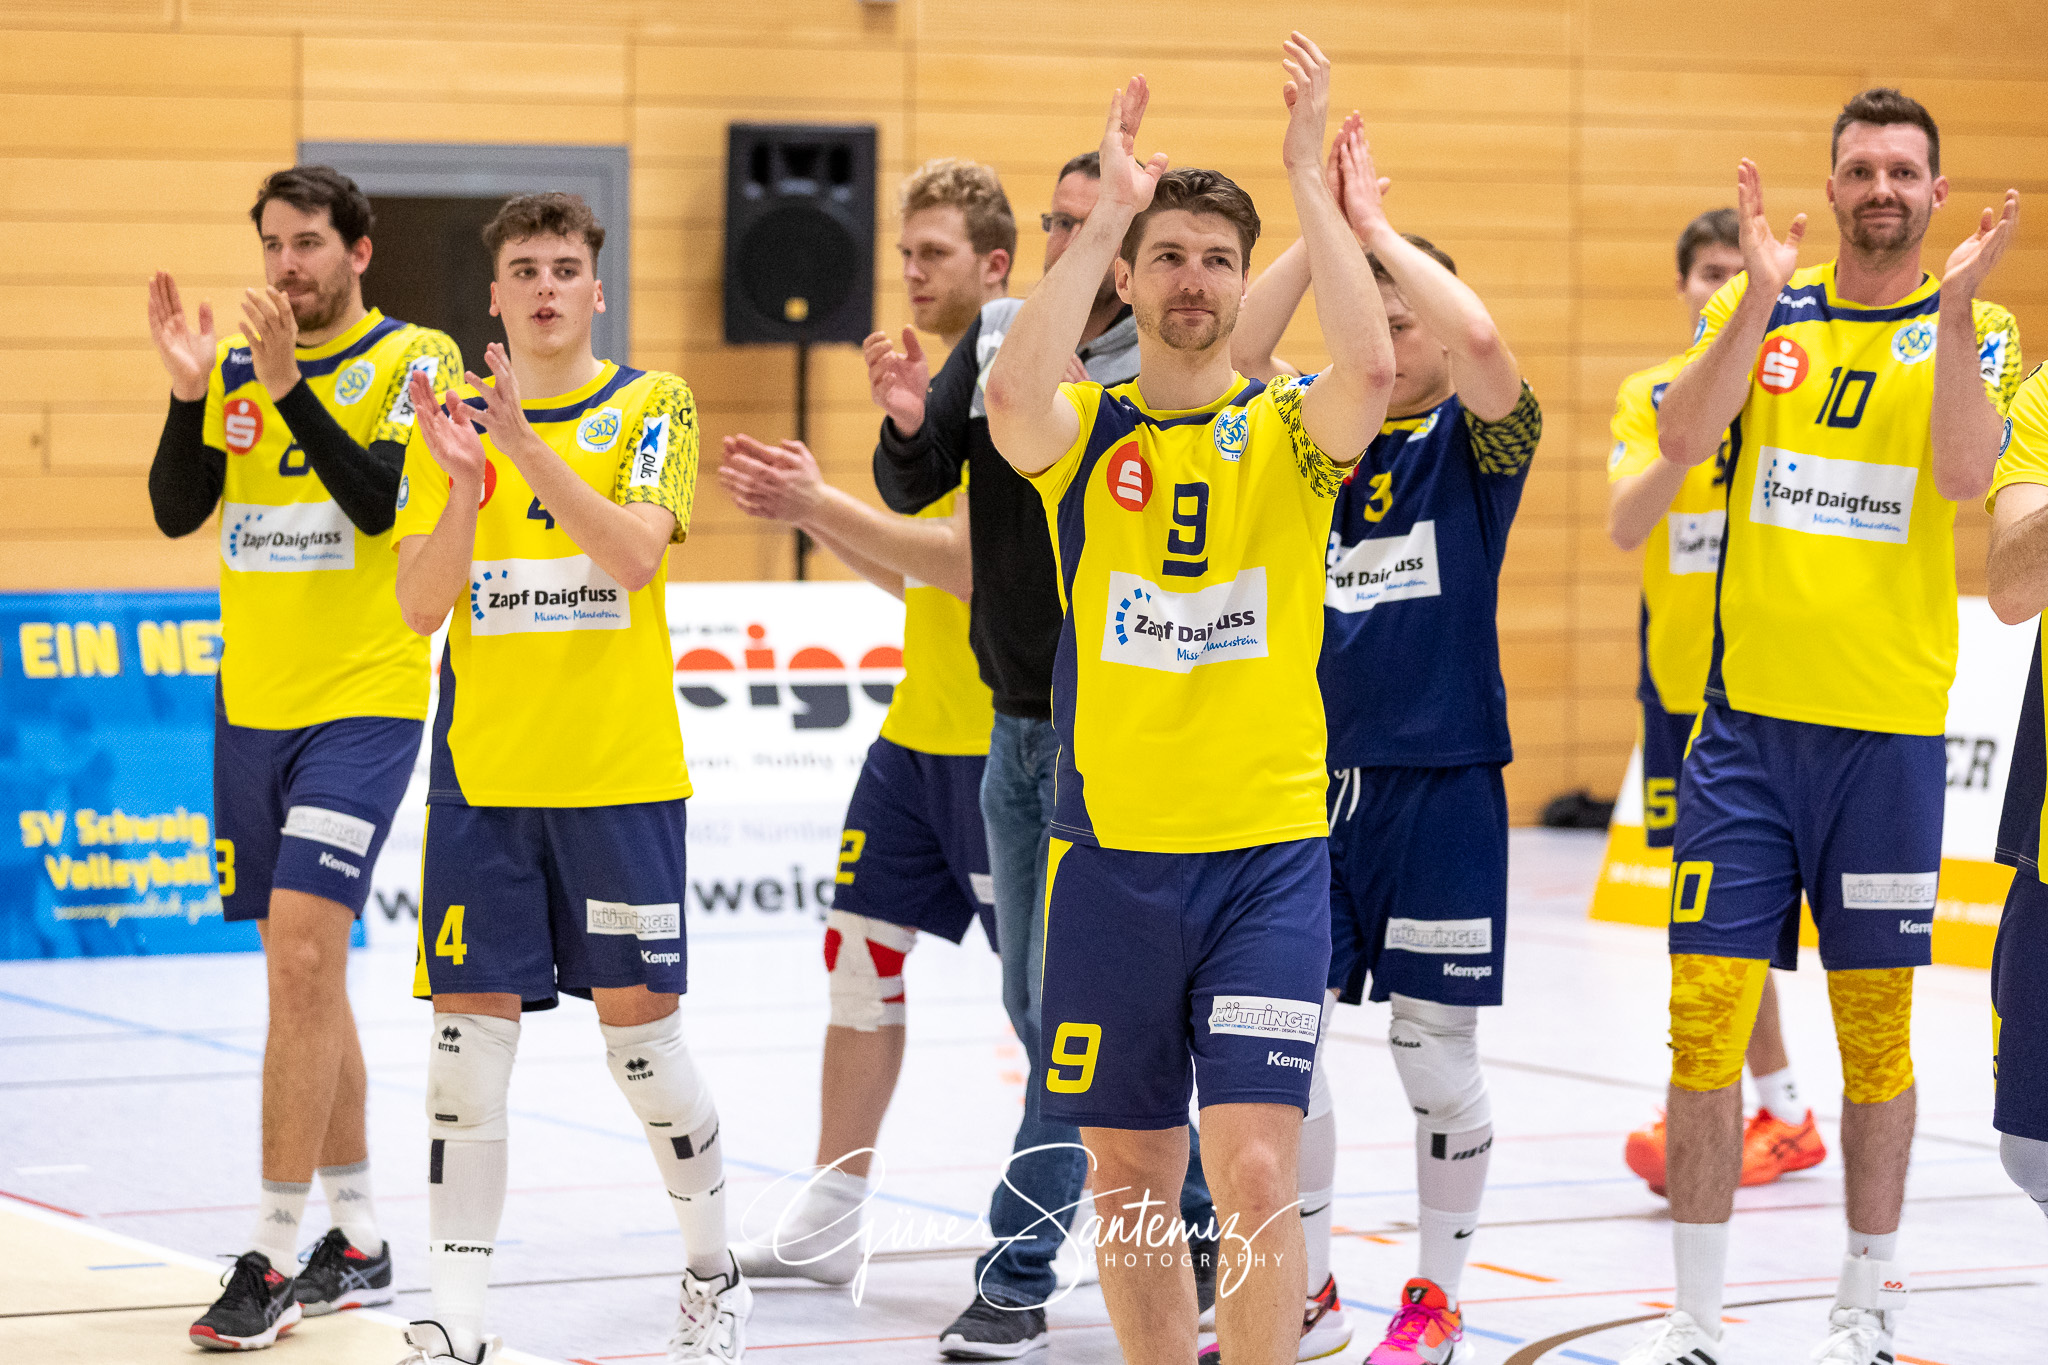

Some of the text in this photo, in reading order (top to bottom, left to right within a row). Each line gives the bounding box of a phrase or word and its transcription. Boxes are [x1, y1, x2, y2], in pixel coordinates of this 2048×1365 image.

[1815, 366, 1877, 429] 10
[1364, 471, 1393, 523] 3
[1772, 482, 1901, 515] Zapf Daigfuss
[1166, 482, 1209, 556] 9
[1358, 557, 1423, 586] Daiuss
[489, 586, 617, 610] Zapf Daigfuss
[1134, 610, 1256, 643] Zapf Daiuss
[19, 621, 120, 679] EIN
[1646, 776, 1678, 830] 5
[19, 807, 210, 848] SV Schwaig
[45, 853, 213, 894] Volleyball
[435, 904, 468, 966] 4
[1899, 919, 1934, 937] Kem
[640, 950, 681, 967] Kempa
[1443, 962, 1493, 981] Kempa
[1046, 1022, 1102, 1093] 9
[1266, 1050, 1312, 1074] Kempa
